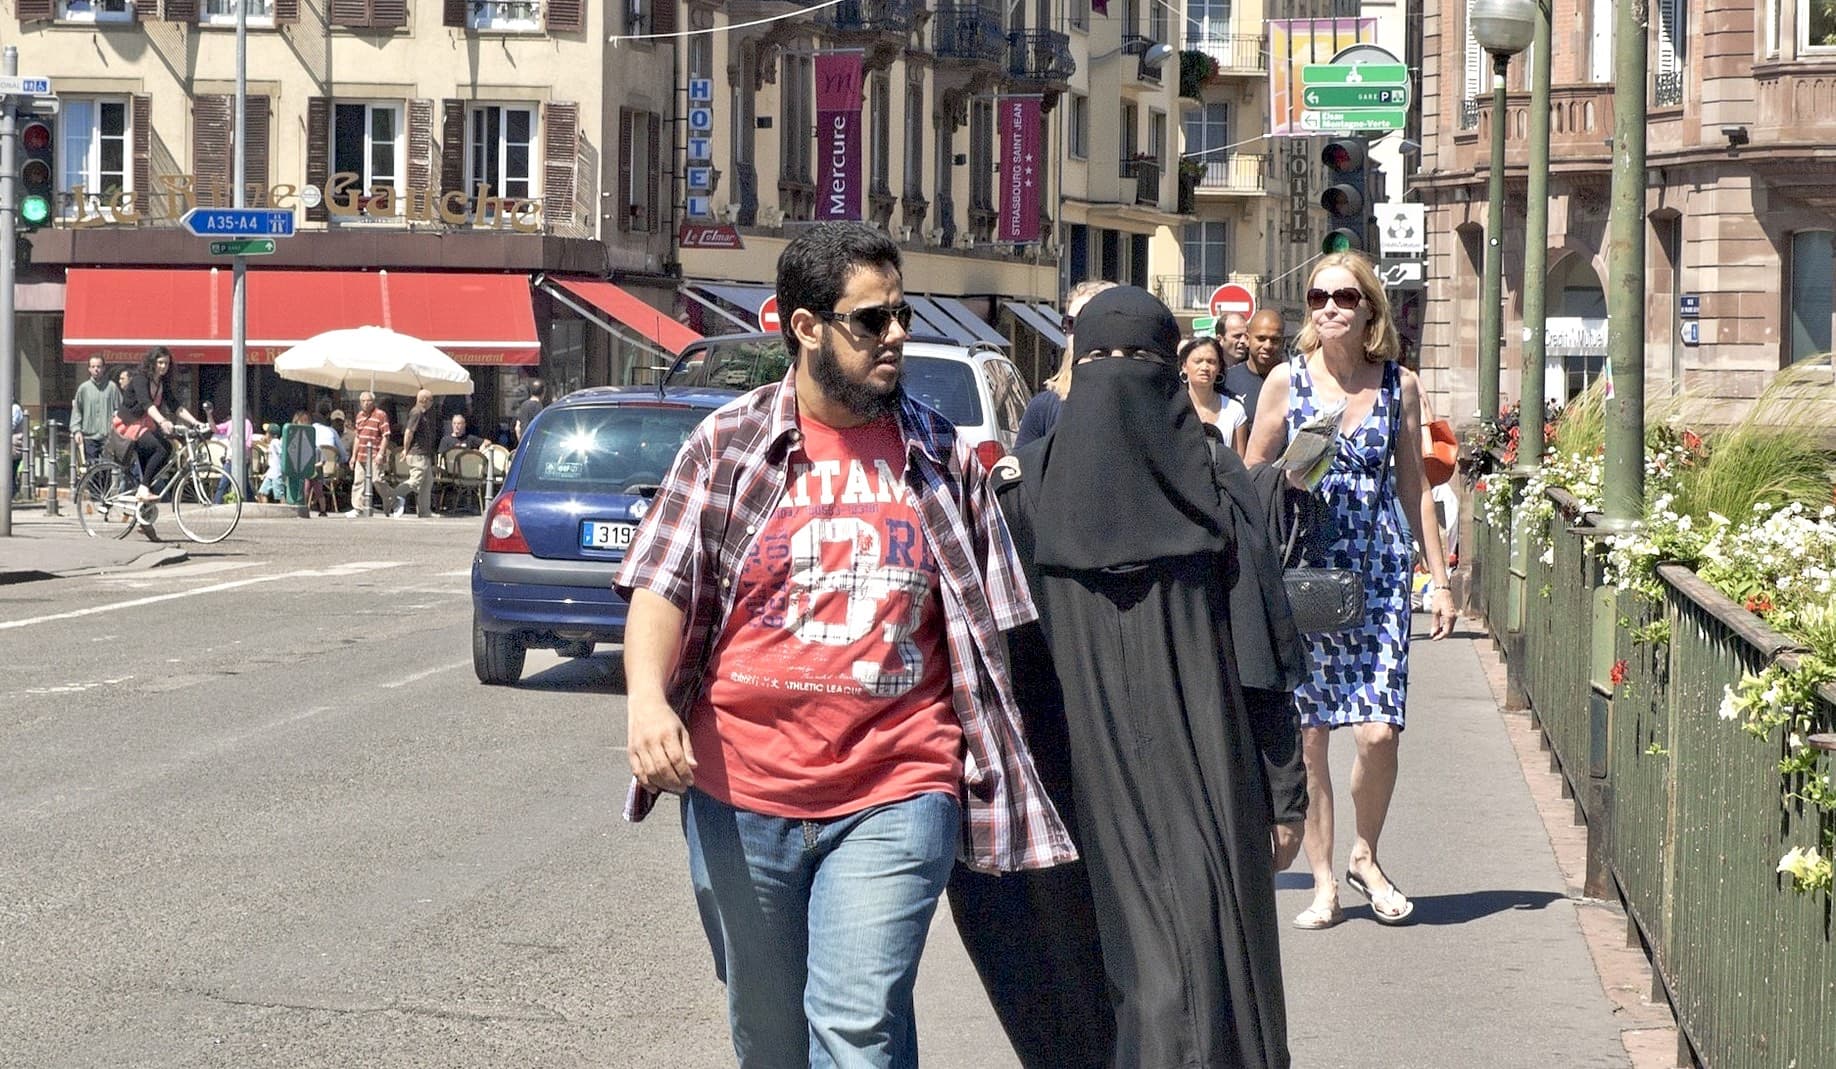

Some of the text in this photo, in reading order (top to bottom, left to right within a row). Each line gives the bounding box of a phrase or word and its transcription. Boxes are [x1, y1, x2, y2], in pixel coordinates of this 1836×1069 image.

[690, 81, 709, 216] HOTEL
[830, 116, 846, 214] Mercure
[1012, 103, 1022, 236] STRASBOURG SAINT JEAN
[72, 185, 141, 229] Le
[325, 172, 541, 233] Gauche
[1292, 140, 1307, 231] HOTEL
[207, 216, 258, 230] A35-A4
[684, 229, 735, 246] Le Colmar
[599, 525, 637, 544] 319
[785, 680, 823, 692] ATHLETIC
